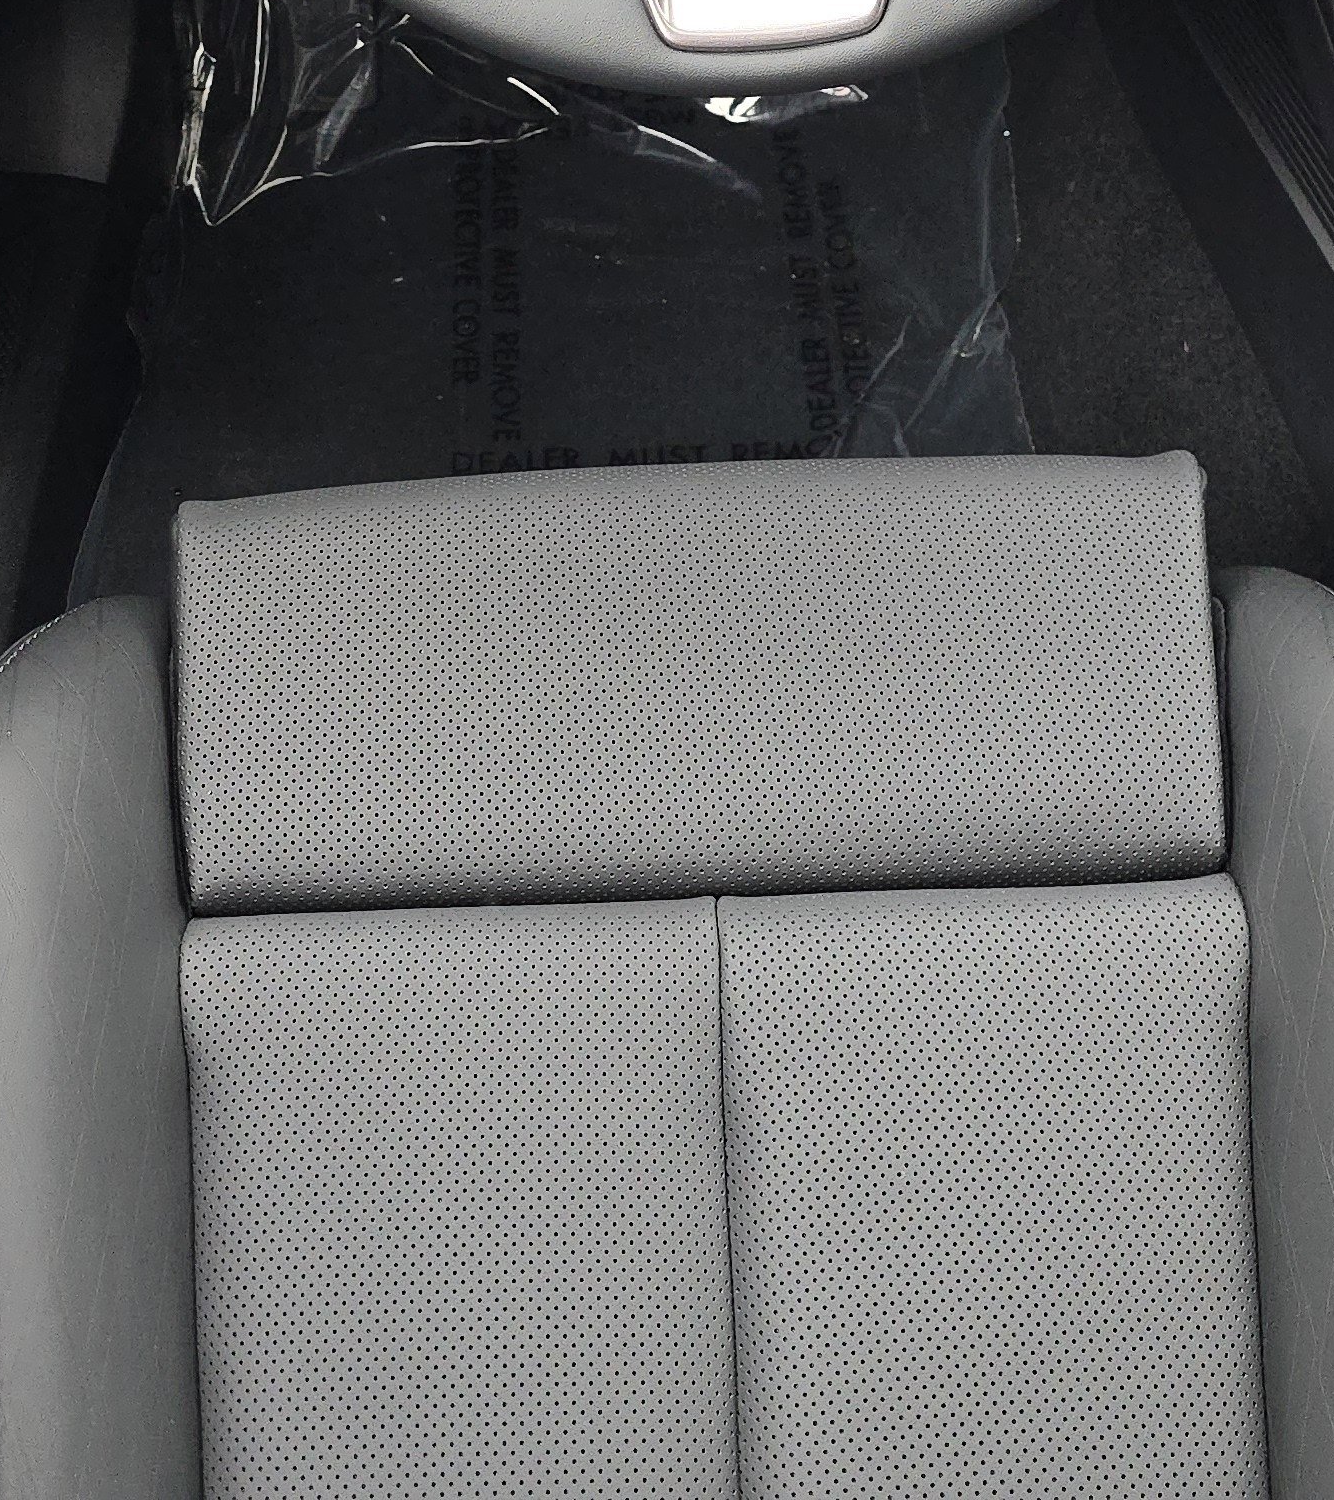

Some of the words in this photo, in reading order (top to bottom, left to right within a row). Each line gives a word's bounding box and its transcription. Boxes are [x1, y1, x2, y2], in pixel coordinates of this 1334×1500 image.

[453, 147, 482, 290] PROTECTIVE
[492, 147, 521, 233] DEALER
[772, 127, 812, 239] REMOVE
[816, 180, 857, 272] COVER
[491, 246, 521, 316] MUST
[788, 255, 821, 321] MUST
[451, 299, 481, 385] COVER
[800, 338, 839, 433] DEALER
[830, 283, 870, 396] OTECTIVE
[489, 331, 522, 443] REMOVE
[450, 446, 580, 476] DEALER
[607, 444, 707, 467] MUST
[730, 434, 831, 463] REMO
